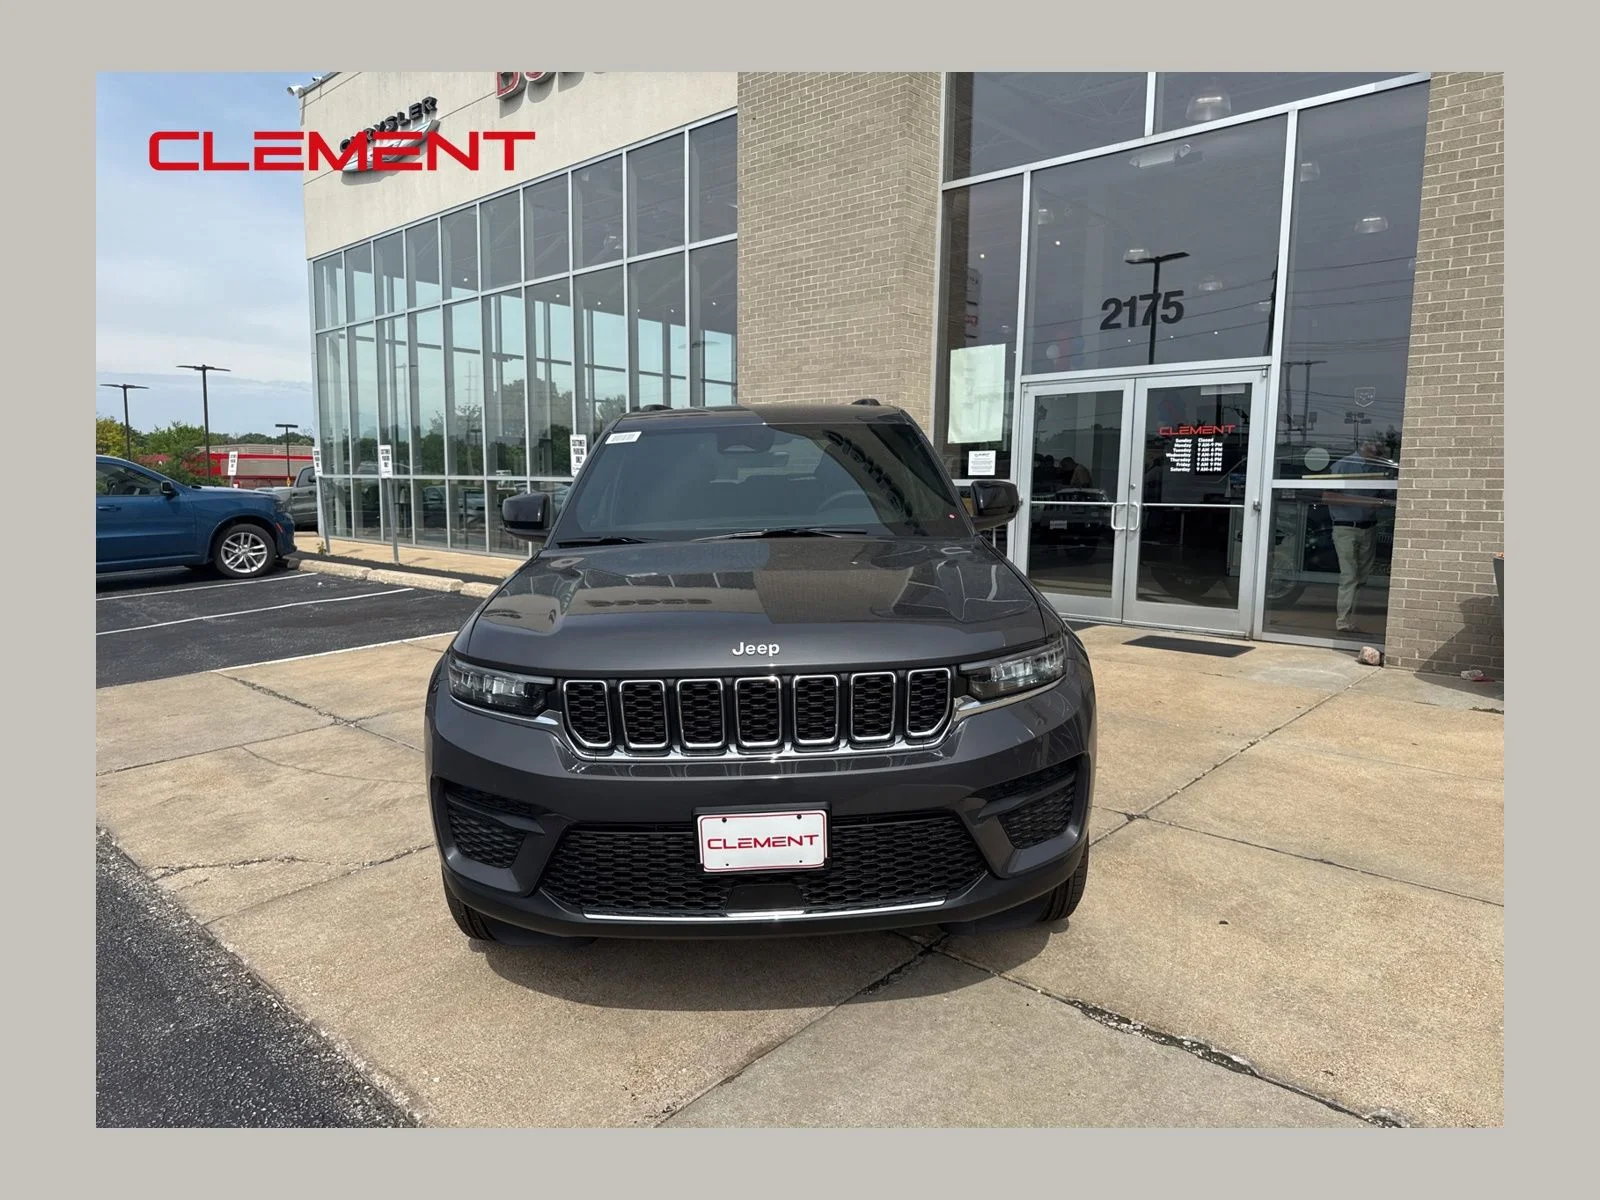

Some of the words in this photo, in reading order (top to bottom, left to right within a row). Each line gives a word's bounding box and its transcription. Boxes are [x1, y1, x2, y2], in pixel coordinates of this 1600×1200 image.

[340, 96, 438, 153] CRYSLER
[1100, 290, 1184, 330] 2175
[1159, 425, 1236, 436] CLEMENT
[732, 642, 780, 657] Jeep
[707, 834, 819, 850] CLEMENT
